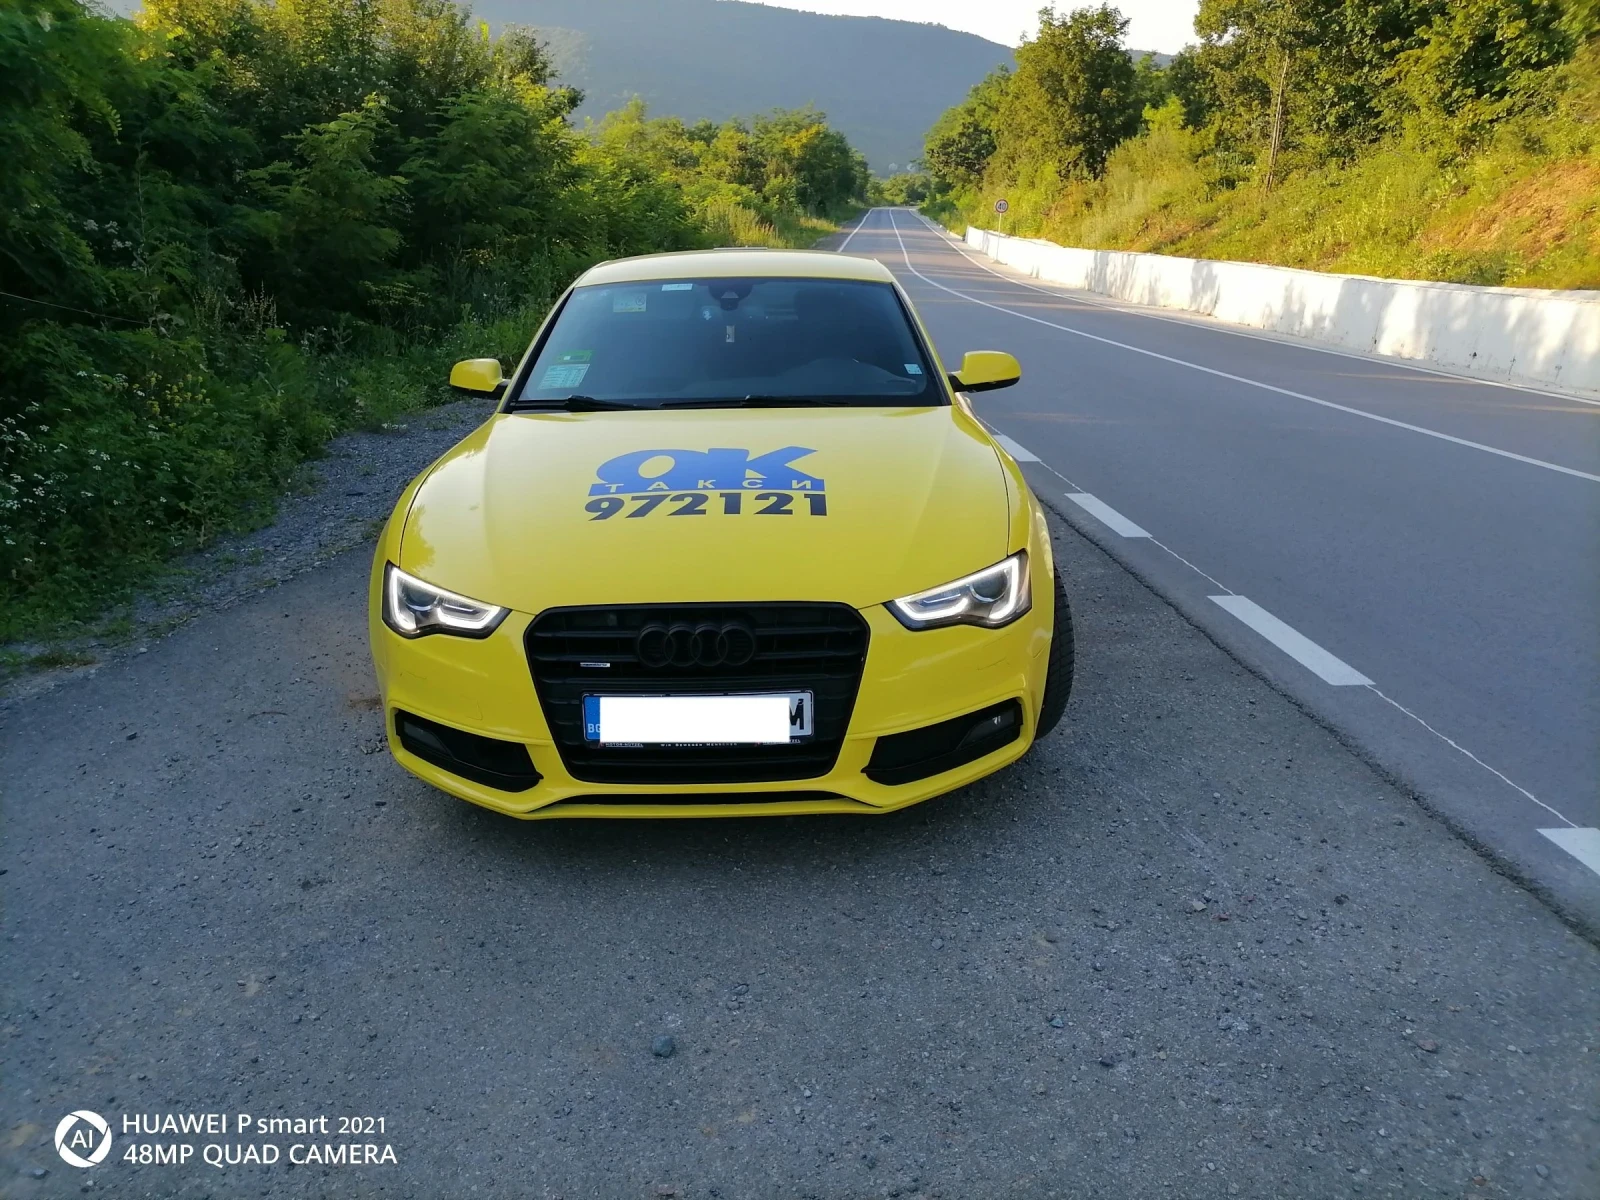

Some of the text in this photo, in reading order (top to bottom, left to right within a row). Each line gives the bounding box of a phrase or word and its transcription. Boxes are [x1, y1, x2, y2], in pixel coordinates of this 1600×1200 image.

[997, 202, 1007, 211] 40
[605, 479, 812, 493] ТАКСИ
[584, 492, 828, 521] 972121
